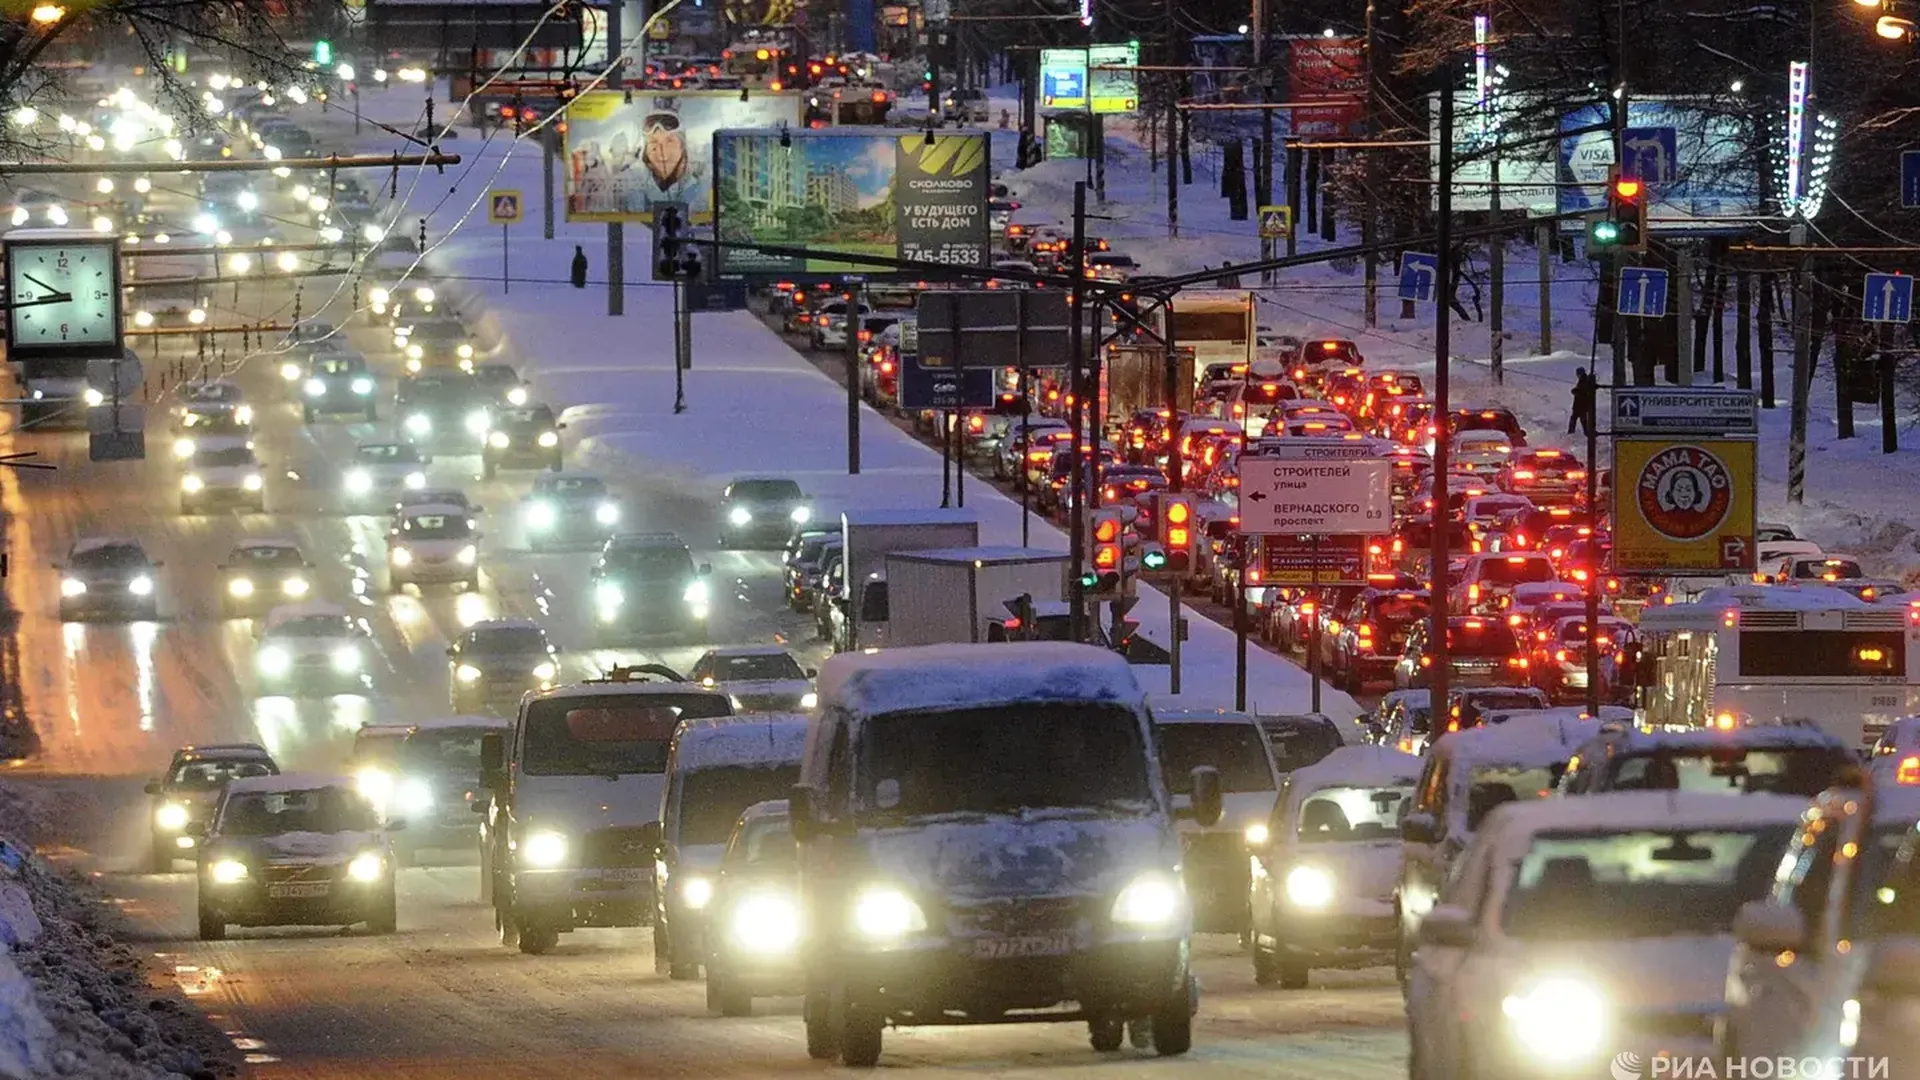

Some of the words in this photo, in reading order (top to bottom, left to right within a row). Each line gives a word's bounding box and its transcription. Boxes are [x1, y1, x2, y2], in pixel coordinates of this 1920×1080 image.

[1580, 150, 1609, 160] VISA
[909, 180, 973, 188] СКОЛКОВО
[903, 205, 912, 216] У
[914, 204, 978, 217] БУДУЩЕГО
[911, 218, 939, 228] ЕСТЬ
[942, 217, 970, 230] ДОМ
[903, 249, 980, 264] 745-5533
[57, 258, 68, 268] 12
[25, 291, 33, 300] 9
[94, 290, 101, 300] 3
[60, 324, 68, 333] 6
[1641, 395, 1752, 407] УНИВЕРСИТЕТСКИЙ
[1304, 448, 1368, 456] СТРОИТЕЛЕЙ
[1273, 465, 1350, 477] СТРОИТЕЛЕЙ
[1642, 450, 1690, 490] МАМА
[1697, 453, 1726, 489] ТАО
[1273, 481, 1307, 491] улица
[1273, 504, 1360, 515] ВЕРНАДСКОГО
[1366, 510, 1382, 519] 0.9
[1273, 518, 1325, 527] проспект
